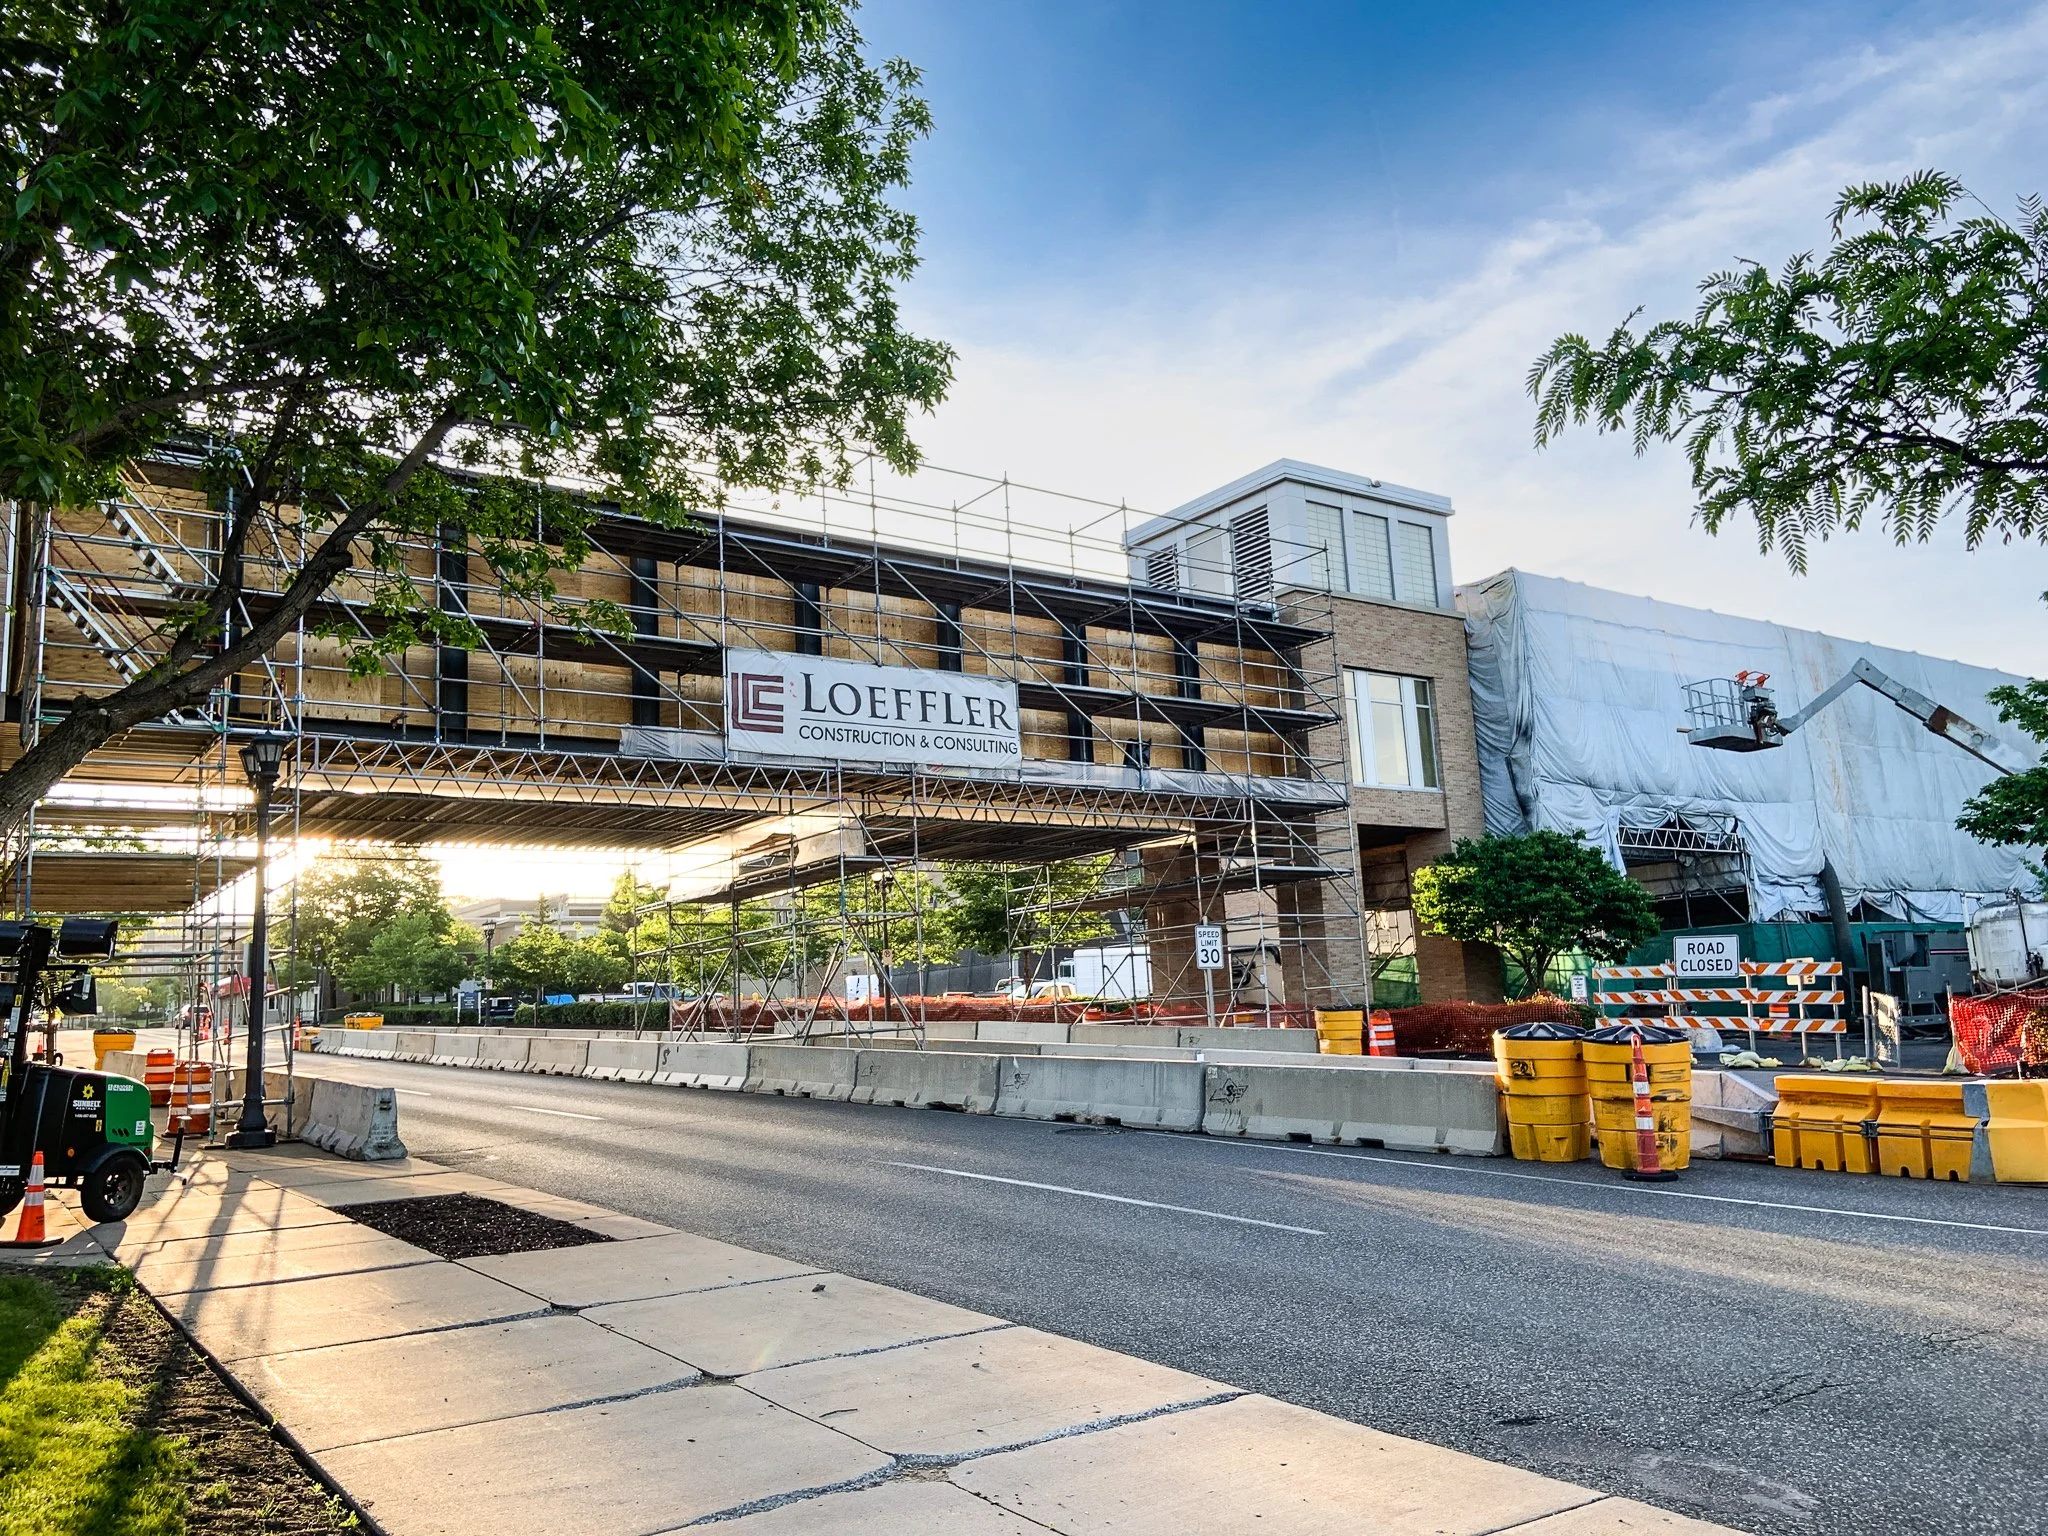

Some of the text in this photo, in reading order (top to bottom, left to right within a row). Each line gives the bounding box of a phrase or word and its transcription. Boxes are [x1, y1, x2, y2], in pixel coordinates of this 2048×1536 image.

[800, 671, 1016, 731] LOEFFLER
[799, 725, 1018, 755] CONSTRUCTION & CONSULTING
[1198, 930, 1219, 938] SPEED
[1200, 948, 1220, 963] 30
[1687, 942, 1725, 955] ROAD
[1680, 958, 1733, 972] CLOSED
